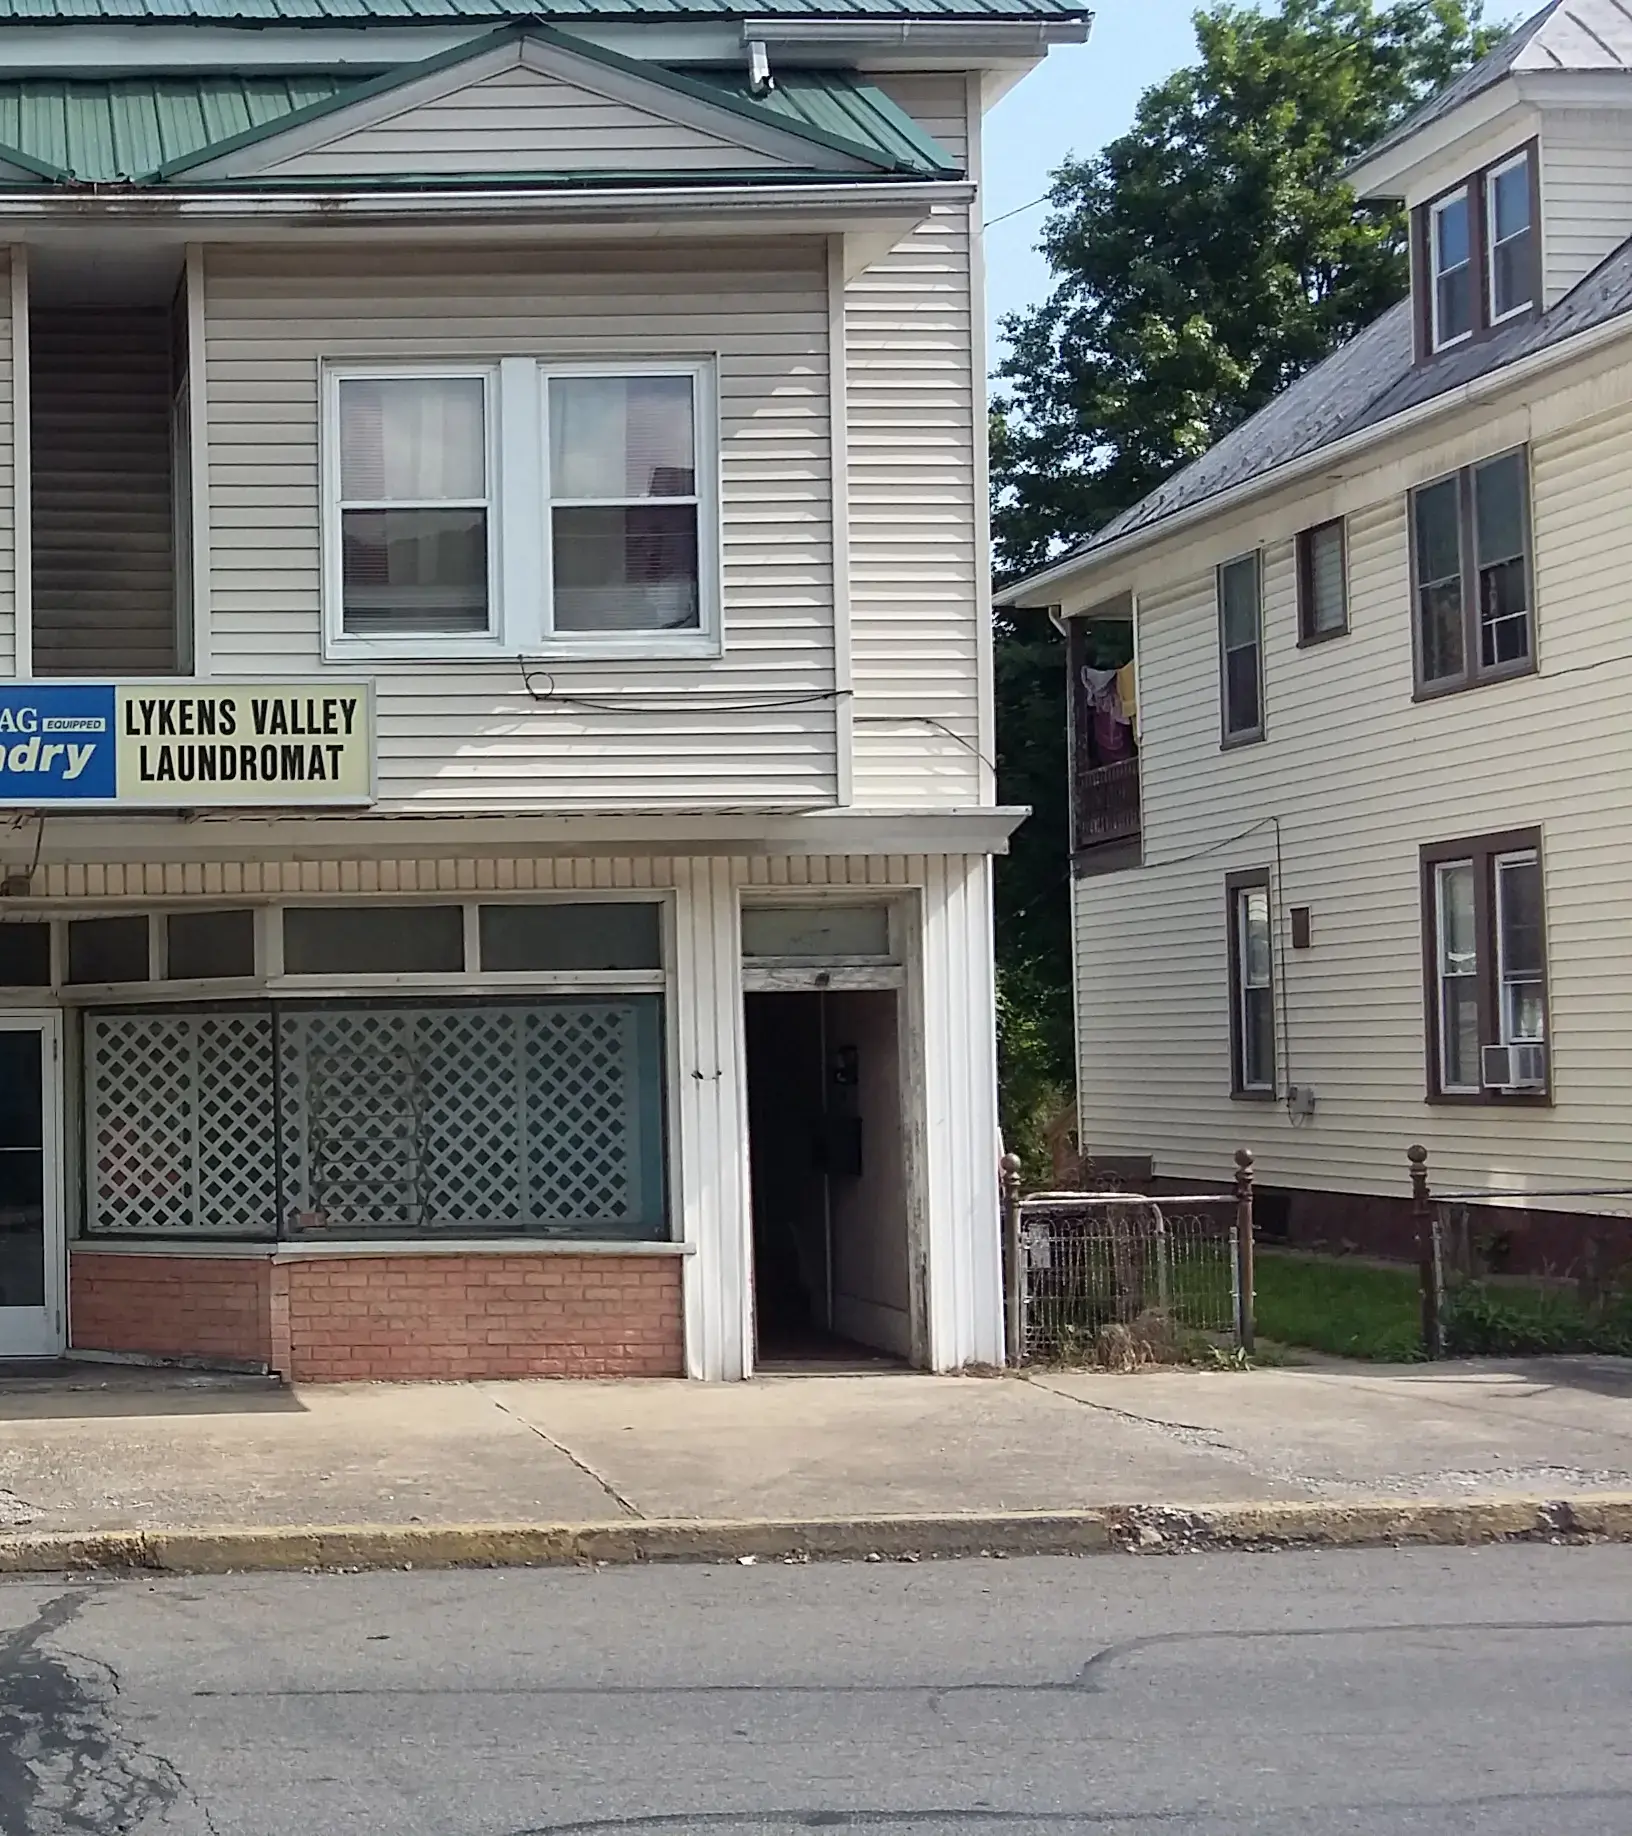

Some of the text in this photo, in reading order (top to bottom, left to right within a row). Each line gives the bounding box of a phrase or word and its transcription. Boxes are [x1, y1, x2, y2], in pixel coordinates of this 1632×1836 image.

[46, 719, 102, 730] EQUIPPED
[125, 698, 357, 736] LYKENS VALLEY
[140, 744, 344, 781] LAUNDROMAT
